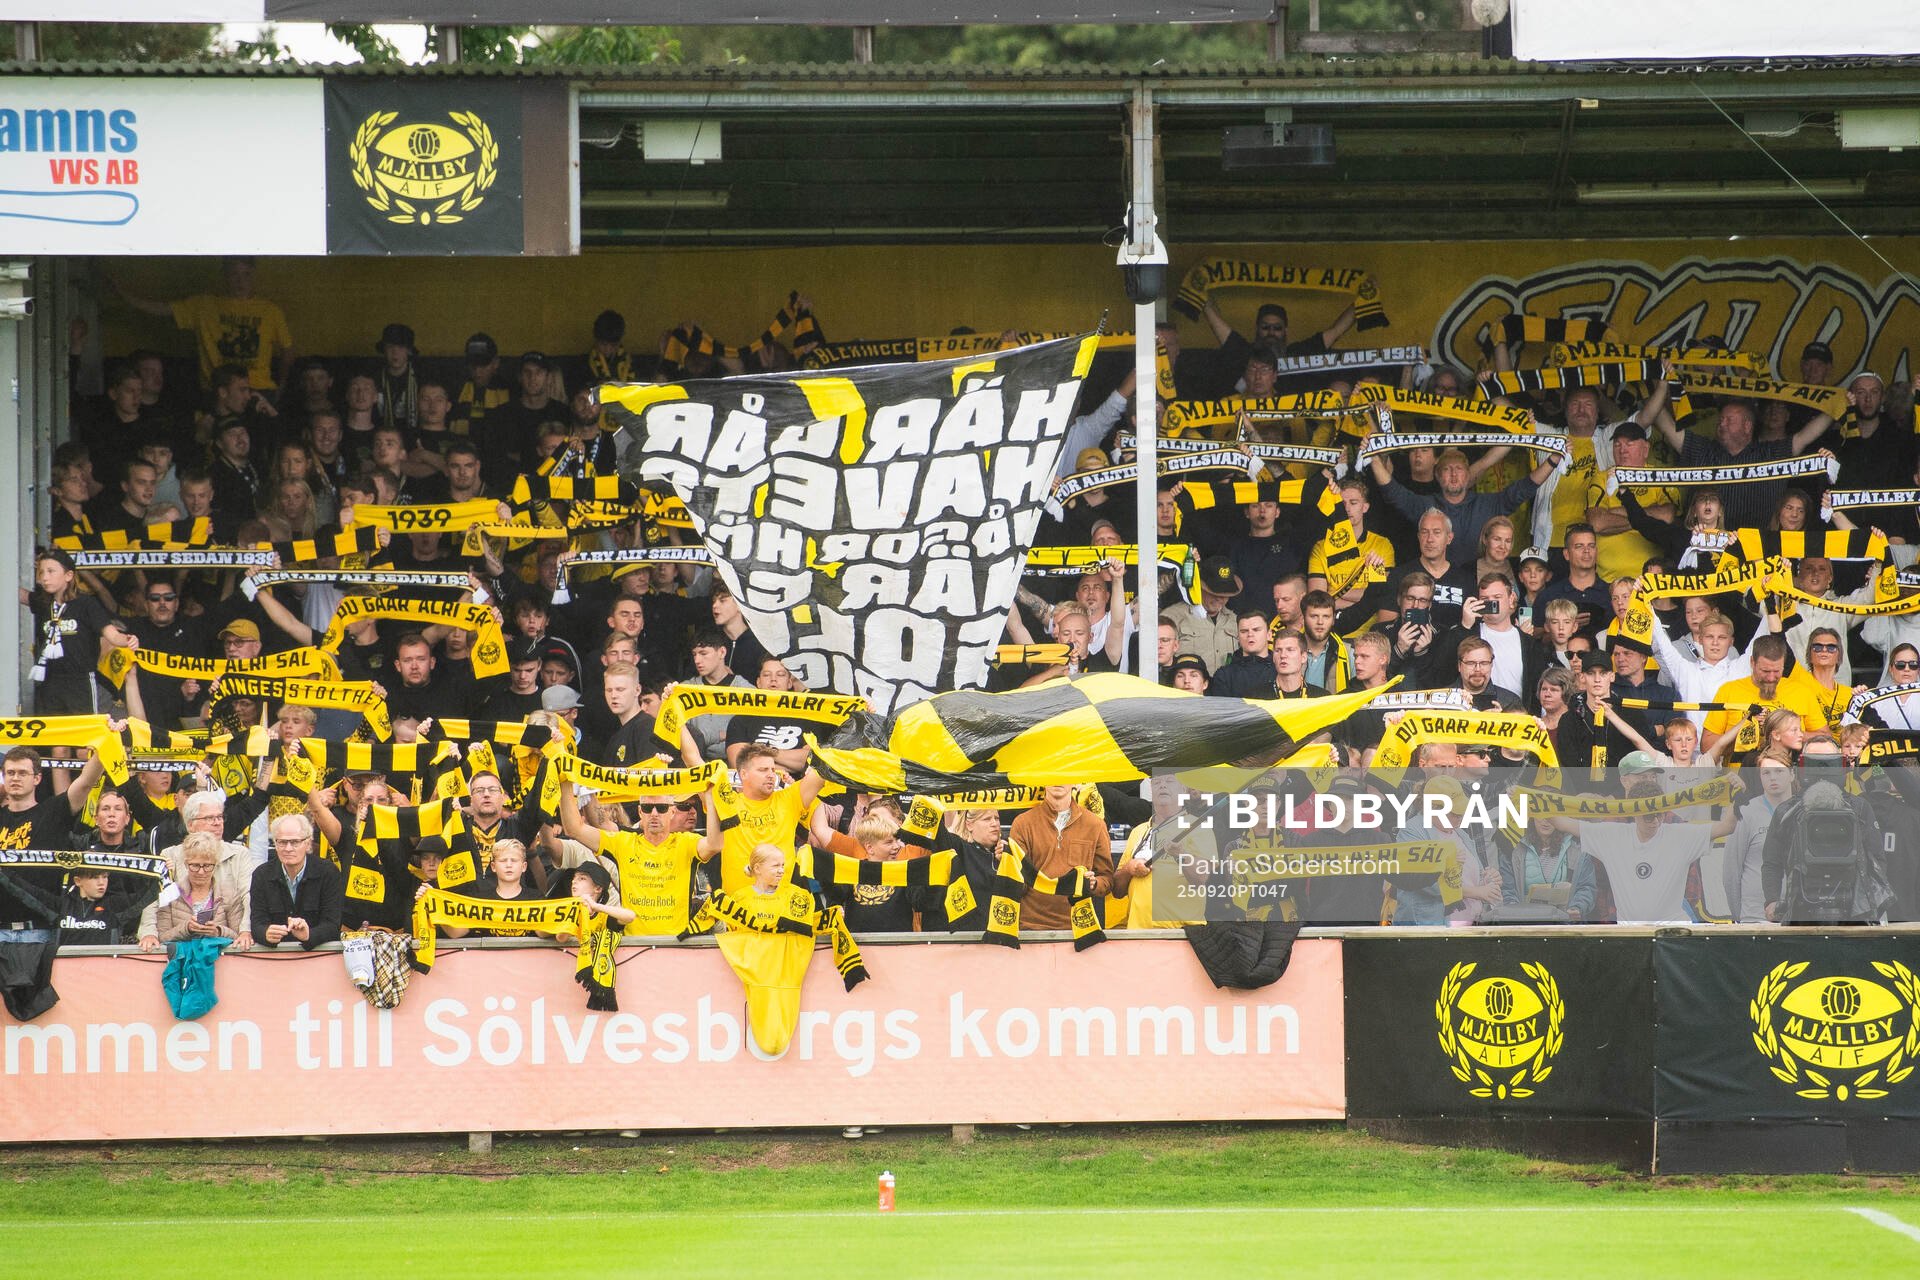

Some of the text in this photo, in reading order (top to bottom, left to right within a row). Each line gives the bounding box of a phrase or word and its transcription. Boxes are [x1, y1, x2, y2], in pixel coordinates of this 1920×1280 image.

[49, 159, 139, 185] VVS AB
[378, 157, 468, 180] MJÄLLBY
[1320, 268, 1364, 288] AIF
[1293, 390, 1333, 411] AIF
[1361, 387, 1387, 402] DU
[1393, 390, 1443, 406] GAAR
[1452, 399, 1497, 416] ALRI
[1168, 452, 1250, 470] GULSVART
[1248, 446, 1340, 464] GULSVART
[1616, 469, 1652, 483] 1939
[1655, 469, 1713, 482] SEDAN
[1715, 468, 1744, 480] AIF
[1831, 491, 1914, 506] MJÄLLBY
[387, 509, 451, 530] 1939
[137, 553, 167, 565] AIF
[170, 553, 233, 565] SEDAN
[617, 549, 647, 561] AIF
[648, 549, 709, 561] SEDAN
[1654, 572, 1708, 590] GAAR
[1716, 560, 1757, 587] ALRI
[337, 599, 359, 619] DU
[364, 598, 408, 612] GAAR
[419, 600, 459, 618] ALRI
[135, 650, 159, 666] DU
[166, 654, 215, 672] GAAR
[224, 657, 267, 673] ALRI
[678, 692, 707, 711] DU
[713, 692, 767, 707] GAAR
[777, 694, 824, 711] ALRI
[1396, 718, 1418, 743] DU
[1421, 718, 1469, 733] GAAR
[1476, 720, 1518, 737] ALRI
[580, 763, 629, 787] GAAR
[638, 770, 681, 787] ALRI
[443, 900, 494, 921] GAAR
[503, 906, 545, 923] ALRI
[60, 916, 107, 930] ellesse
[4, 1021, 263, 1075] mmen
[289, 1000, 393, 1070] till
[949, 990, 1300, 1058] kommun
[1459, 1015, 1538, 1044] MJÄLLBY
[1784, 1015, 1894, 1044] MJÄLLBY
[1480, 1044, 1518, 1066] AIF
[1811, 1044, 1866, 1066] AIF
